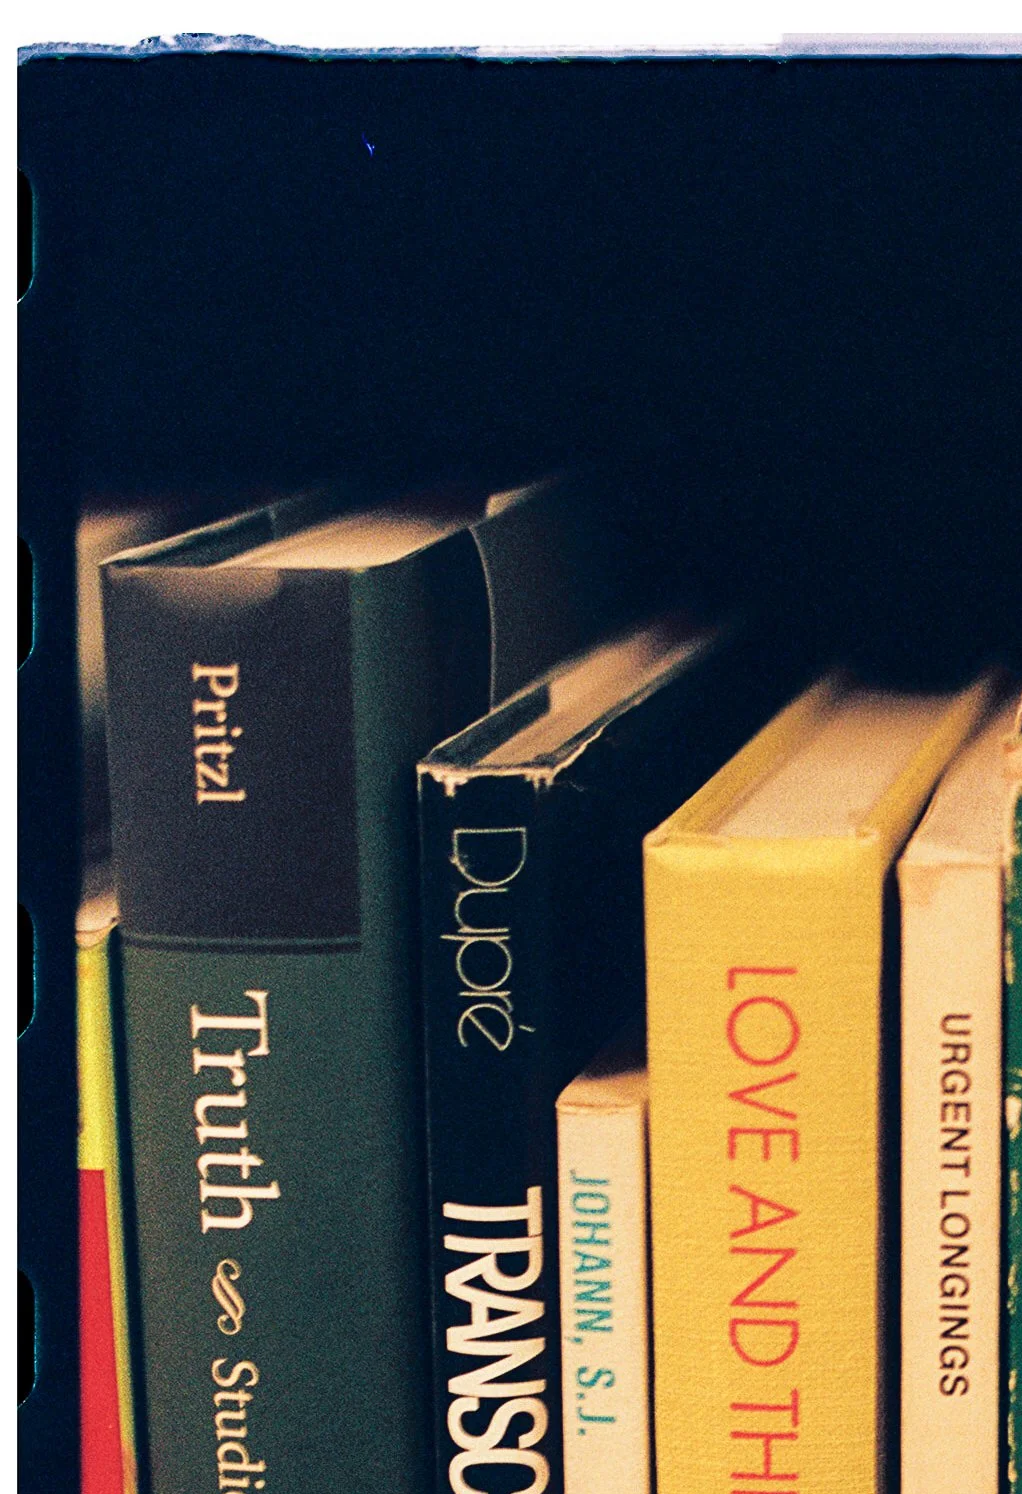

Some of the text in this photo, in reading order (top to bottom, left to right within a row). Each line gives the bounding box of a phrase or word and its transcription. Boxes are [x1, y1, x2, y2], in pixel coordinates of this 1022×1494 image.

[190, 662, 247, 805] Pritzl
[440, 826, 535, 1052] Dupré
[188, 988, 282, 1236] Truth
[726, 966, 801, 1163] LOVE
[568, 1170, 617, 1436] JOHANN, S.J.
[727, 1185, 800, 1368] AND
[938, 1012, 972, 1398] URGENT LONGINGS
